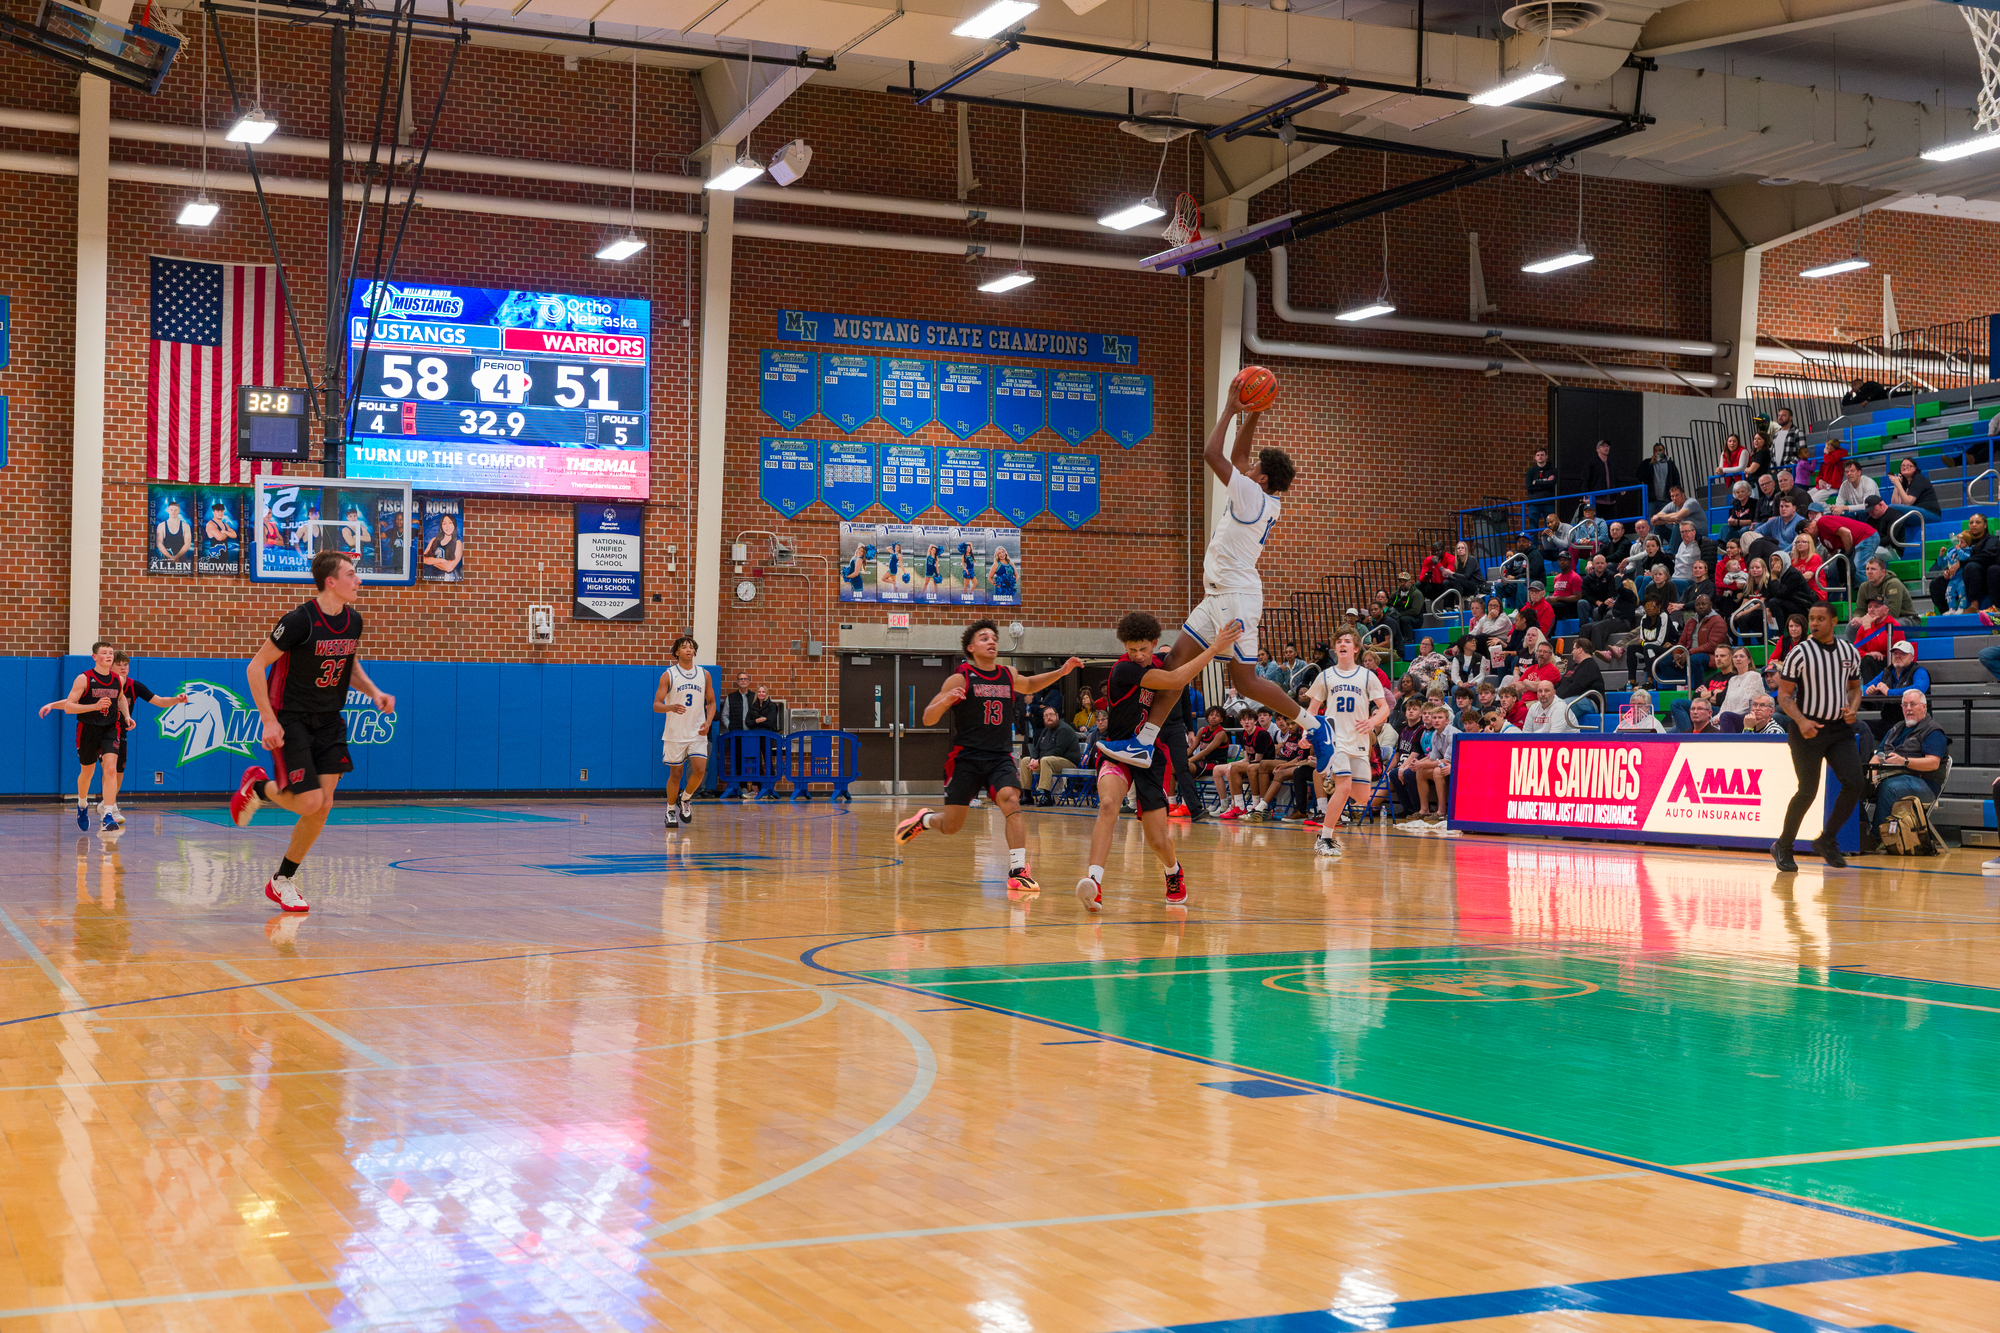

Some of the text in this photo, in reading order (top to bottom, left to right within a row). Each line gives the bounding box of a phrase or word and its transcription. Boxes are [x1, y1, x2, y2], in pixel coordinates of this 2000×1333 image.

[404, 288, 452, 298] MILLARD NORTH
[392, 296, 459, 314] MUSTANGS
[567, 299, 612, 314] Ortho
[567, 311, 637, 330] Nebraska
[786, 310, 818, 341] MN
[355, 321, 466, 344] MUSTANGS
[834, 318, 1089, 356] MUSTANG STATE CHAMPIONS
[542, 334, 642, 356] WARRIORS
[1102, 335, 1132, 363] MN
[483, 362, 522, 372] PERIOD
[380, 354, 450, 400] 58
[492, 374, 511, 398] 4
[554, 365, 619, 410] 51
[248, 393, 289, 412] 32.8
[358, 402, 398, 412] FOULS
[370, 414, 385, 434] 4
[459, 410, 526, 436] 32.9
[602, 415, 640, 425] FOULS
[614, 428, 628, 445] 5
[354, 447, 546, 470] TURN UP THE COMFORT
[566, 458, 637, 474] THERMAL
[571, 482, 632, 492] ThermalServices.com
[378, 499, 420, 514] FISCR
[425, 501, 460, 514] ROCHA
[150, 562, 192, 571] ALLEN
[199, 562, 238, 571] BROWNE
[892, 615, 907, 627] EXIT
[676, 683, 702, 693] MUSTANGS
[1330, 684, 1362, 696] MUSTANGS
[685, 693, 693, 707] 3
[1336, 696, 1355, 713] 20
[983, 700, 1003, 725] 13
[1509, 747, 1642, 800] MAX SAVINGS
[1507, 801, 1638, 825] ON MORE THAN JUST AUTO INSURANCE.
[1665, 808, 1760, 822] AUTO INSURANCE
